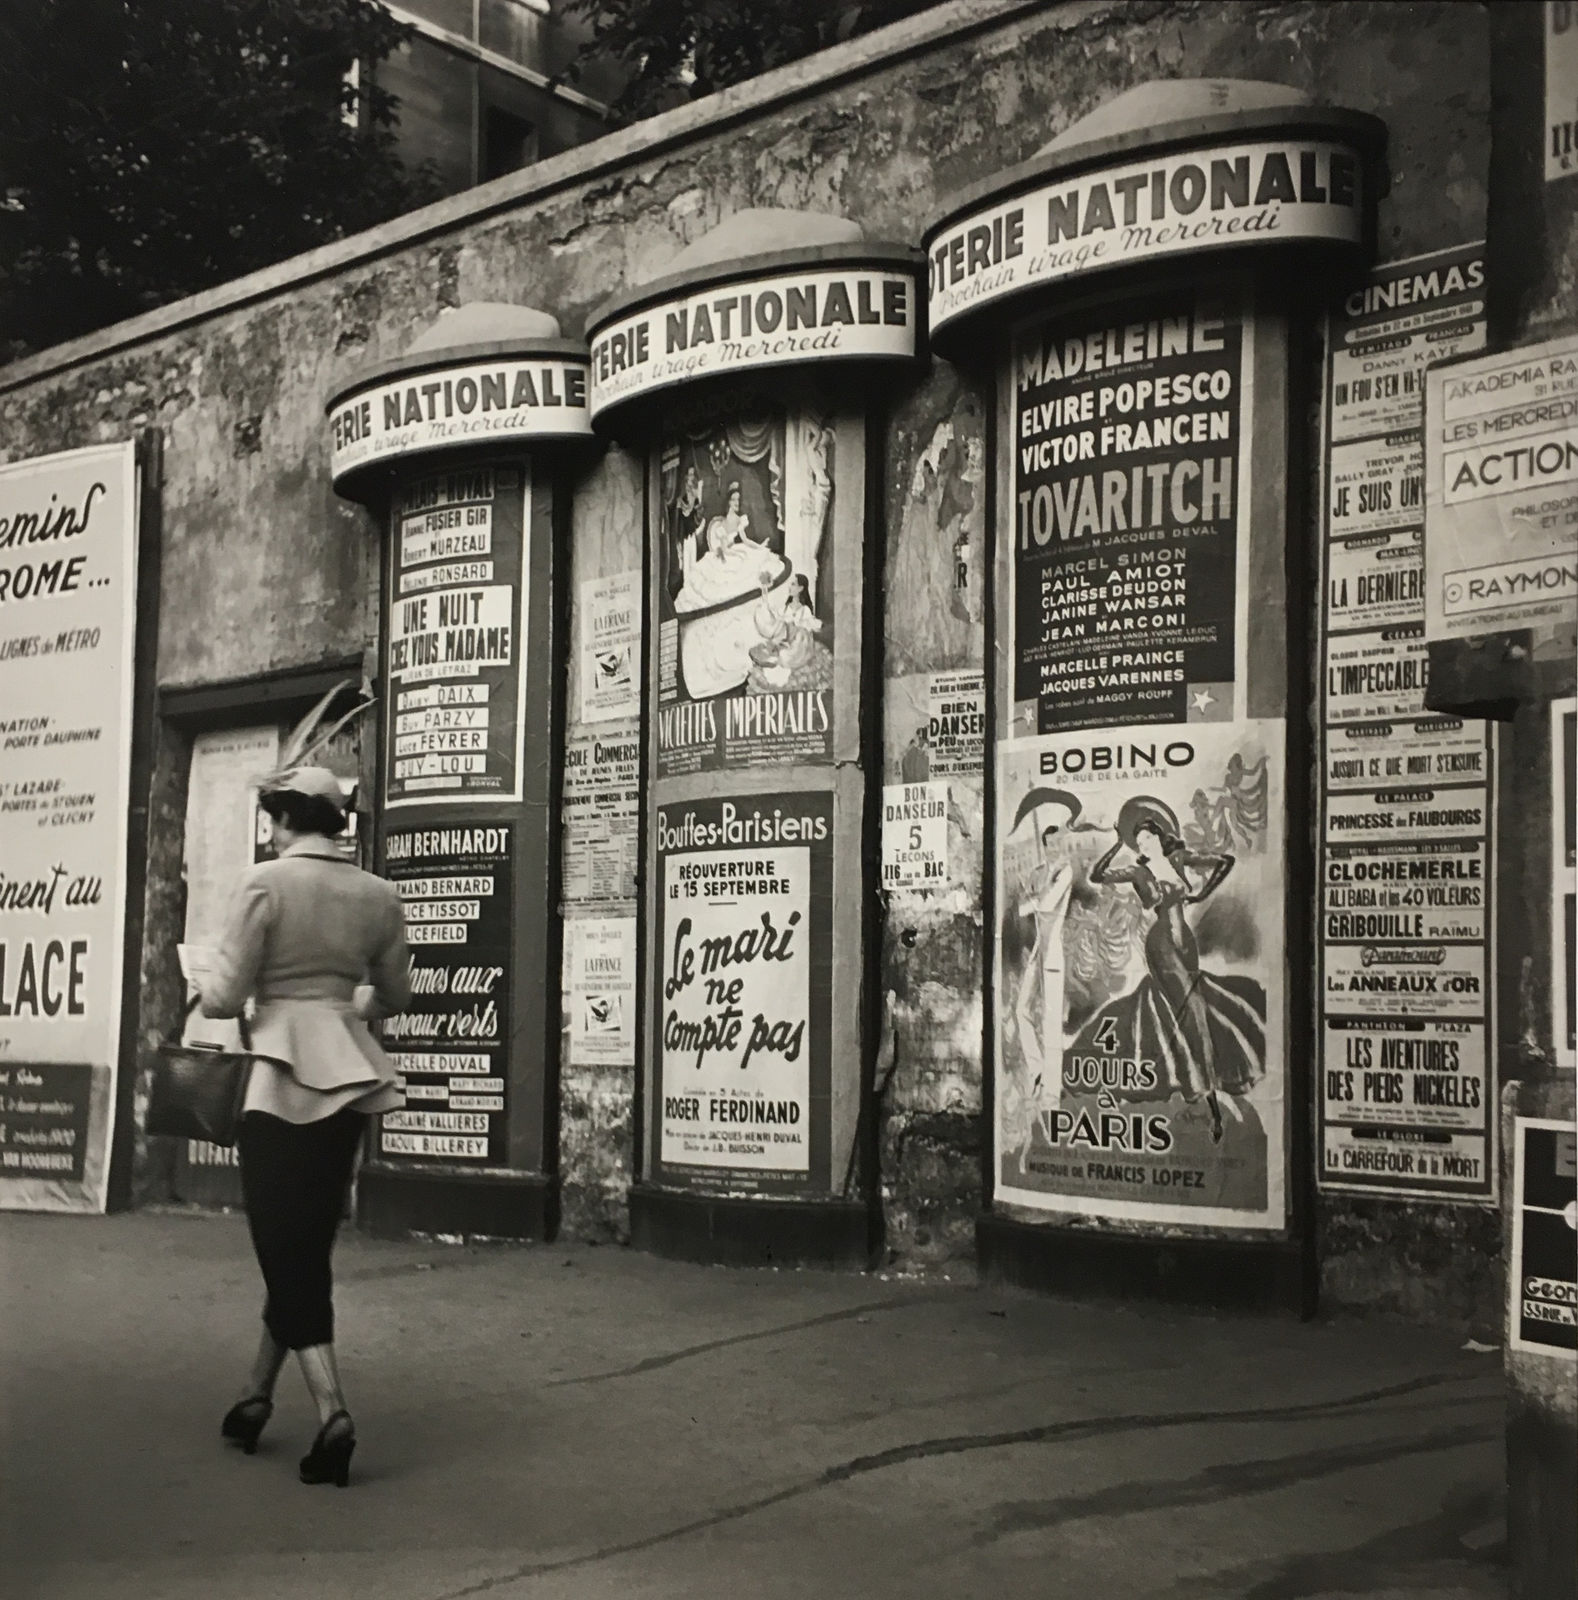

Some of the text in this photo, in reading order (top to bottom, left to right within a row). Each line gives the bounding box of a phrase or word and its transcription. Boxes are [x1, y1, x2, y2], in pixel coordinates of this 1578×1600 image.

[1048, 152, 1354, 246] NATIONALE
[1028, 241, 1106, 271] tirage
[1122, 207, 1281, 249] Mercredi
[1345, 260, 1485, 316] CINEMAS
[666, 280, 907, 354] NATIONALE
[718, 328, 842, 363] Mercredi
[1019, 313, 1224, 392] MADELEINE
[1363, 345, 1458, 373] DANNY KAYE
[1336, 376, 1371, 406] UN FOU
[1449, 359, 1577, 400] AKADEMIA RA
[384, 368, 586, 430] NATIONALE
[1021, 369, 1231, 438] ELVIRE POPESCO
[1022, 410, 1230, 475] VICTOR FRANCEN
[1443, 422, 1478, 443] LES
[1366, 454, 1404, 468] TREVOR
[1335, 472, 1364, 484] SALLY
[1019, 456, 1232, 550] TOVARITCH
[1333, 476, 1419, 517] JE SUIS UN
[466, 507, 487, 526] GIR
[1542, 515, 1558, 529] ET
[430, 535, 486, 557] MURZEAU
[1104, 526, 1218, 546] JACQUES DEVAL
[432, 563, 487, 583] RONSARD
[1041, 547, 1187, 580] MARCEL SIMON
[1041, 563, 1186, 594] PAUL AMIOT
[1041, 578, 1186, 609] CLARISSE DEUDON
[1331, 578, 1348, 608] LA
[403, 591, 484, 634] UNE NUIT
[1041, 594, 1186, 624] JANINE WANSAR
[1446, 613, 1504, 629] INVITATIONS
[1523, 604, 1563, 618] BUREAU
[1041, 613, 1186, 642] JEAN MARCONI
[445, 627, 509, 662] MADAME
[1040, 656, 1108, 677] MARCELLE
[1112, 650, 1185, 668] PRAINCE
[438, 687, 475, 703] DAIX
[1040, 669, 1184, 696] JACQUES VARENNES
[424, 711, 475, 728] PARZY
[726, 691, 828, 740] IMPERIALES
[941, 701, 977, 714] BIEN
[4, 727, 102, 750] PORTE DAUPHINE
[420, 732, 481, 751] FEYRER
[938, 736, 956, 747] PEU
[1040, 741, 1195, 775] BOBINO
[1370, 758, 1381, 776] CE
[1386, 756, 1402, 776] QUE
[1407, 755, 1432, 774] MORT
[1073, 771, 1129, 783] RUE DE LA
[904, 786, 926, 802] BON
[1394, 792, 1430, 801] PALACE
[51, 810, 95, 826] CLICHY
[886, 801, 944, 822] DANSEUR
[1330, 808, 1482, 831] PRINCESSE FAUBOURGS
[386, 828, 509, 859] SARAH BERNHARDT
[909, 825, 922, 850] 5
[924, 861, 944, 878] BAC
[1329, 859, 1481, 881] CLOCHEMERLE
[65, 875, 101, 906] au
[432, 879, 491, 894] BERNARD
[670, 878, 790, 898] LE 15 SEPTEMBRE
[1329, 886, 1481, 907] ALI BABA 40 VOLEURS
[428, 903, 477, 917] TISSOT
[431, 926, 464, 941] FIELD
[1328, 913, 1480, 938] GRIBOUILLE RAIMU
[665, 910, 802, 1000] Le mari
[451, 966, 503, 994] aux
[704, 978, 744, 1005] ne
[1328, 976, 1480, 993] Les ANNEAUX d'OR
[740, 1013, 805, 1069] pas
[1093, 1016, 1120, 1054] 4
[1435, 1023, 1472, 1033] PLAZA
[439, 1055, 487, 1071] DUVAL
[1347, 1037, 1459, 1072] LES AVENTURES
[1063, 1057, 1156, 1090] JOURS
[1098, 1088, 1119, 1112] à
[1328, 1070, 1480, 1108] DES PIEDS NICKELES
[666, 1097, 800, 1124] ROGER FERDINAND
[773, 1133, 802, 1143] DUVAL
[1048, 1107, 1174, 1154] PARIS
[1029, 1162, 1069, 1177] MUSIQUE
[1087, 1162, 1145, 1184] FRANCIS
[1152, 1168, 1205, 1189] LOPEZ
[1343, 1150, 1413, 1173] CARREFOUR
[1443, 1158, 1480, 1178] MORT
